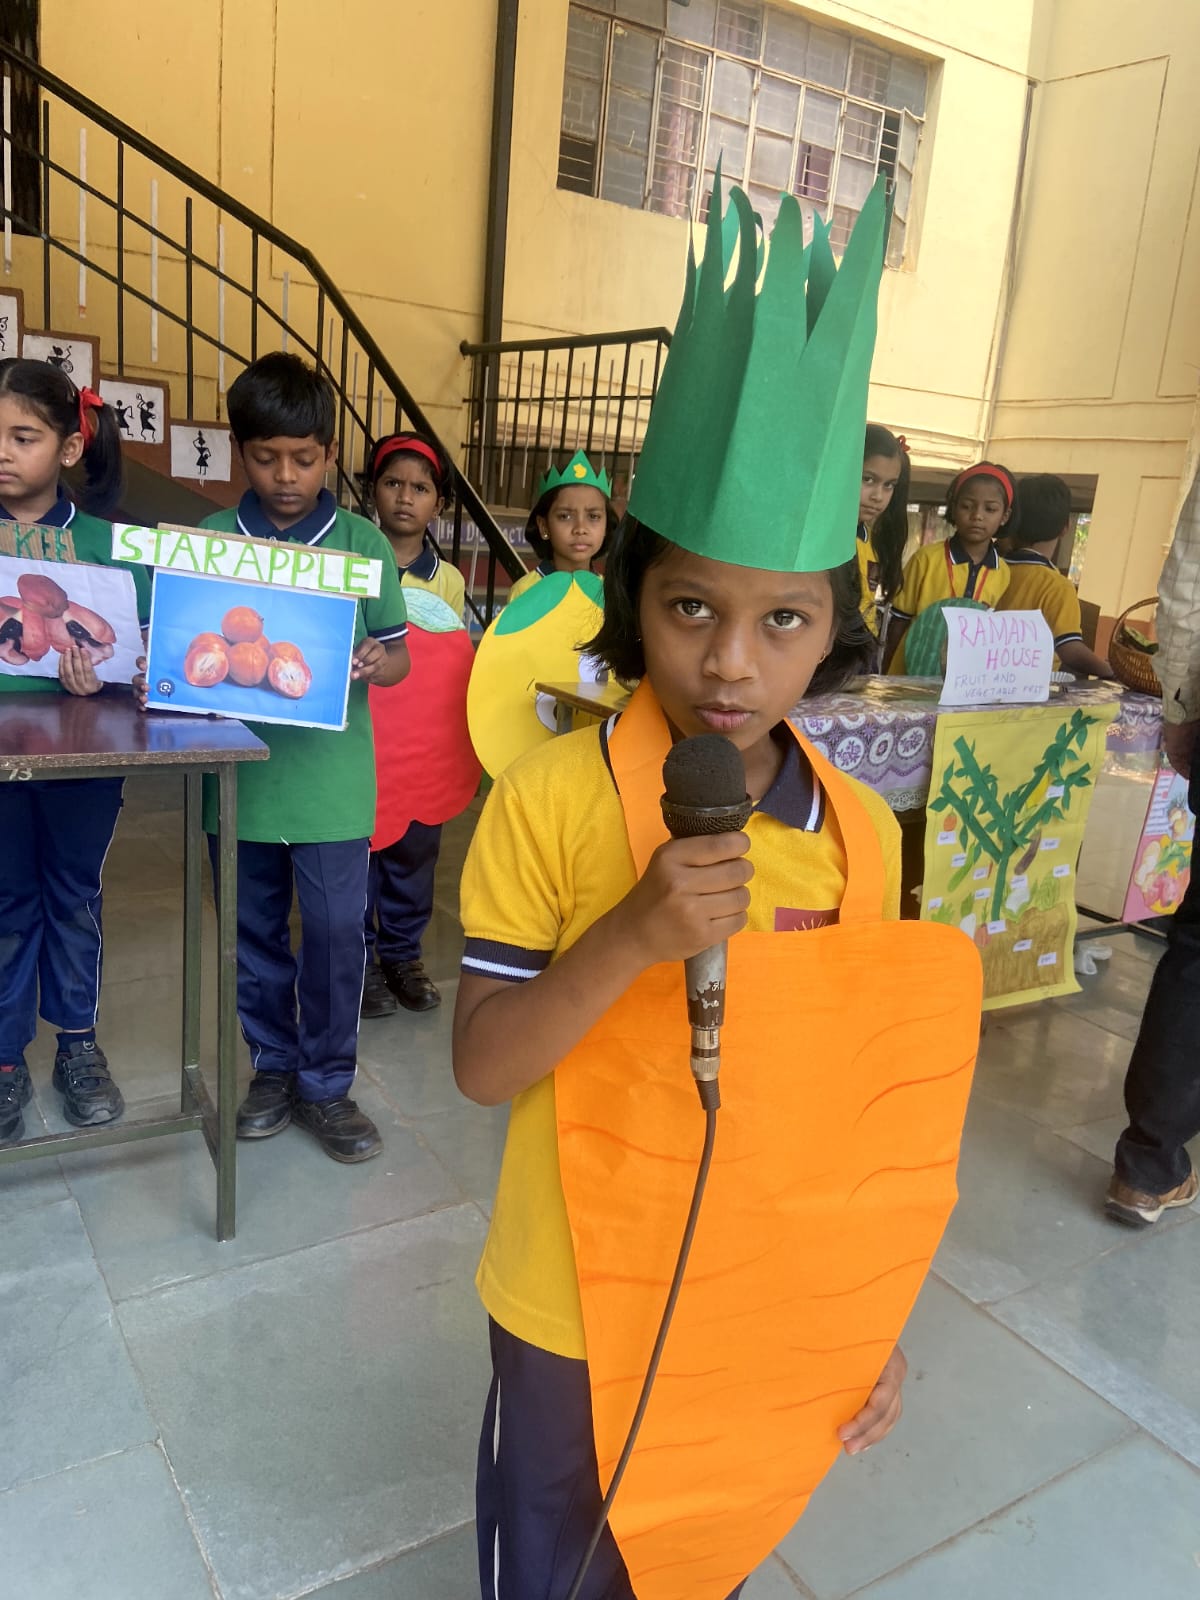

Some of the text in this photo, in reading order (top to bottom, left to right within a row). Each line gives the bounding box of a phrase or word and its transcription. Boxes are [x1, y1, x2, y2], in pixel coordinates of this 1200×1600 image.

[958, 615, 1038, 648] RAMAN
[986, 647, 1042, 671] HOUSE
[954, 672, 1016, 689] FRUIT AND
[963, 687, 1018, 698] VEGETABLE
